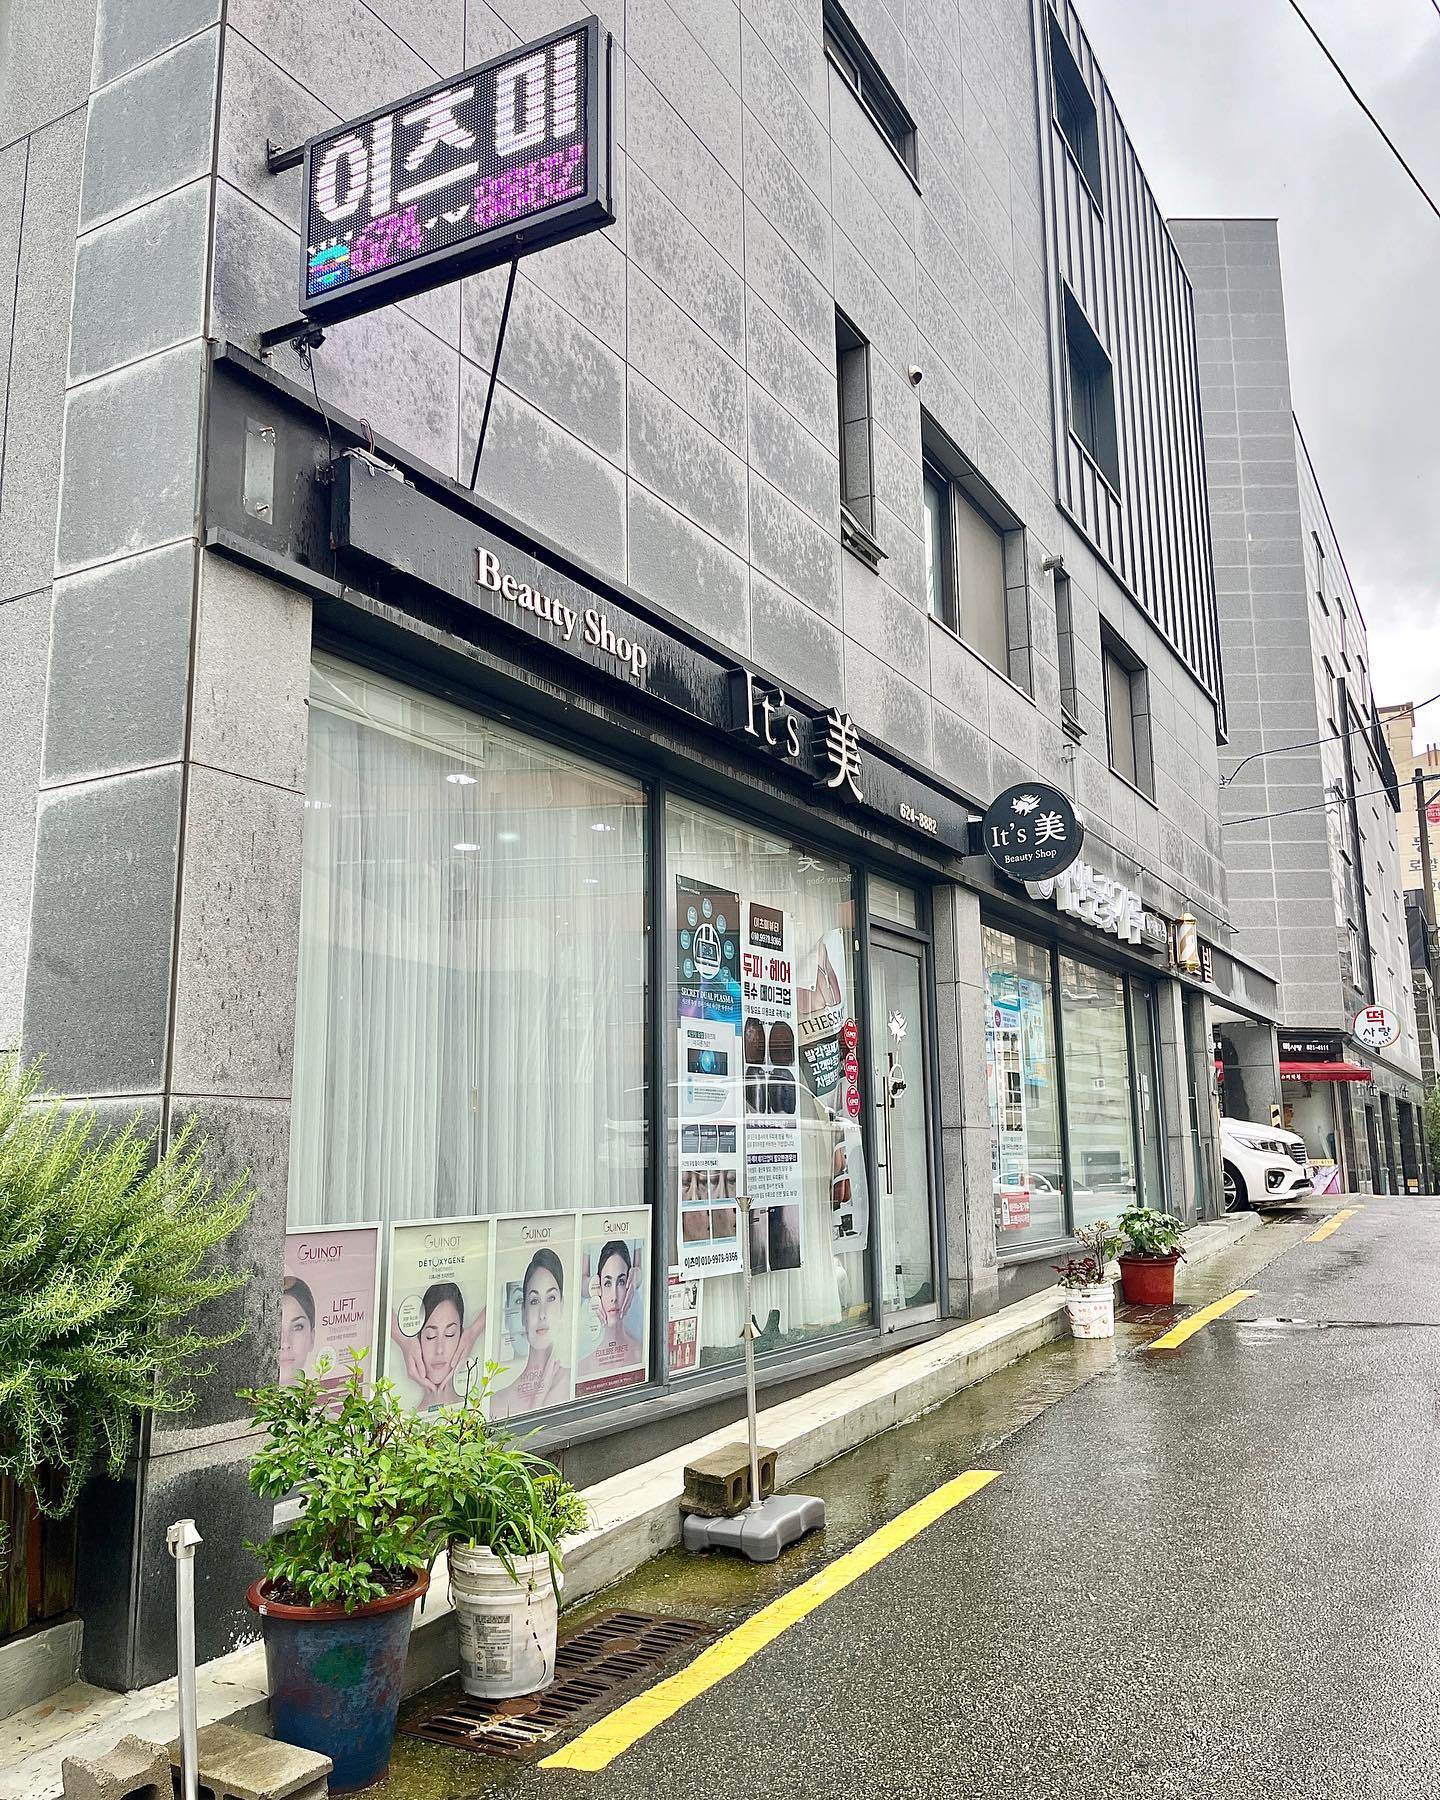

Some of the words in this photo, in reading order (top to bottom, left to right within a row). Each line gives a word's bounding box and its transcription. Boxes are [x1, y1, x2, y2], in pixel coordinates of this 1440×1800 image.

[316, 38, 577, 222] 이츠미
[475, 546, 578, 641] Beauty
[584, 609, 647, 678] Shop
[742, 667, 800, 757] It's
[826, 707, 864, 803] 美
[899, 803, 938, 834] 624-8882
[991, 822, 1027, 848] It's
[1034, 812, 1067, 846] 美
[1004, 853, 1033, 864] Beauty
[1035, 848, 1057, 860] Shop
[681, 986, 701, 999] SECRET
[700, 990, 714, 1002] DUAL
[713, 993, 735, 1005] PLASMA
[759, 984, 792, 1005] 메이크업
[1366, 1010, 1385, 1027] 떡
[521, 1225, 552, 1240] GUINOT
[603, 1220, 630, 1234] GUINOT
[424, 1234, 461, 1249] GUINOT
[297, 1244, 343, 1261] GUINOT
[332, 1297, 356, 1313] LIFT
[322, 1311, 364, 1327] SUMMUM
